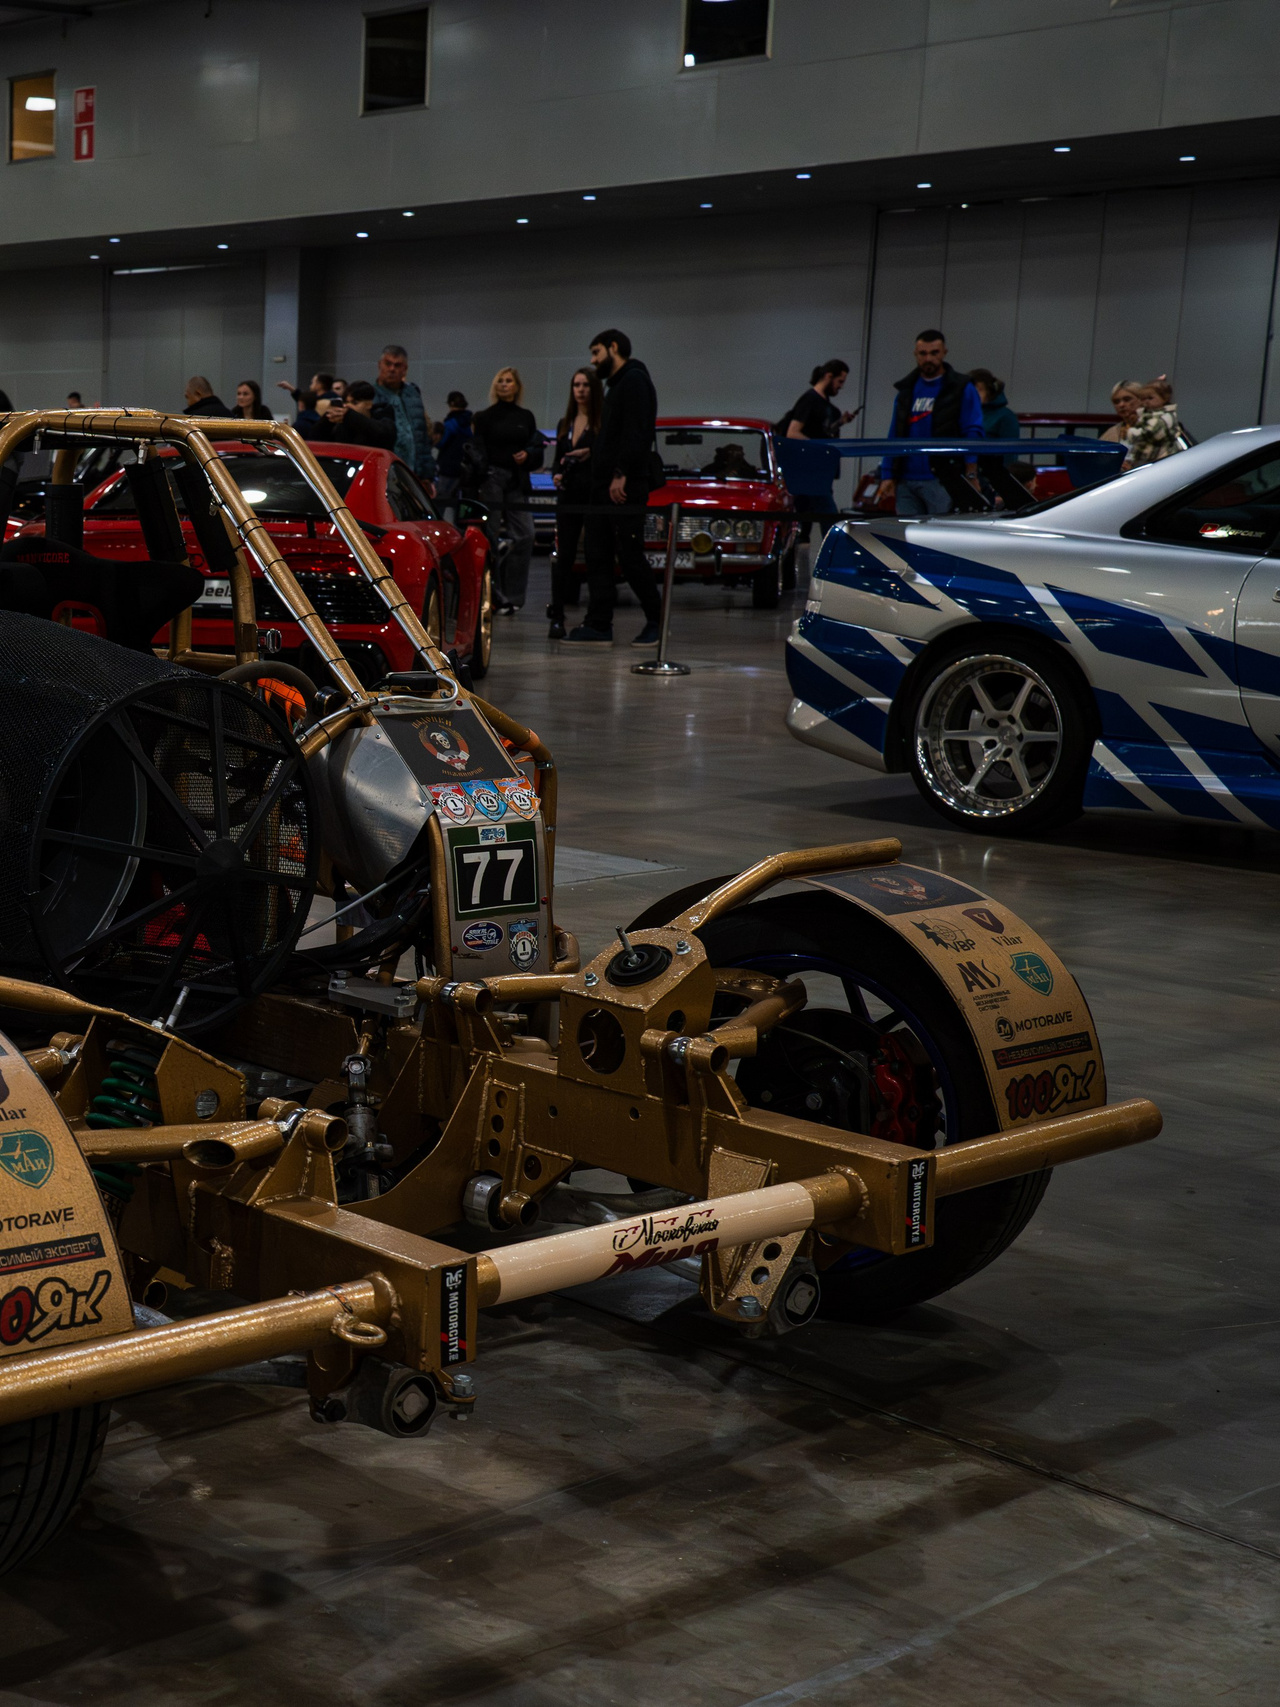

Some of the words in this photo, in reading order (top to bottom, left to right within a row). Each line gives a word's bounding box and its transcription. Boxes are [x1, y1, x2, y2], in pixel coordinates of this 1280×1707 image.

[463, 849, 523, 905] 77
[521, 941, 526, 952] 1
[948, 938, 976, 952] VBP
[991, 934, 1024, 947] Vilar
[1015, 1010, 1073, 1033] MOTORAVE
[613, 1216, 720, 1251] Московская
[44, 1240, 92, 1258] ЭКСПЕРТ
